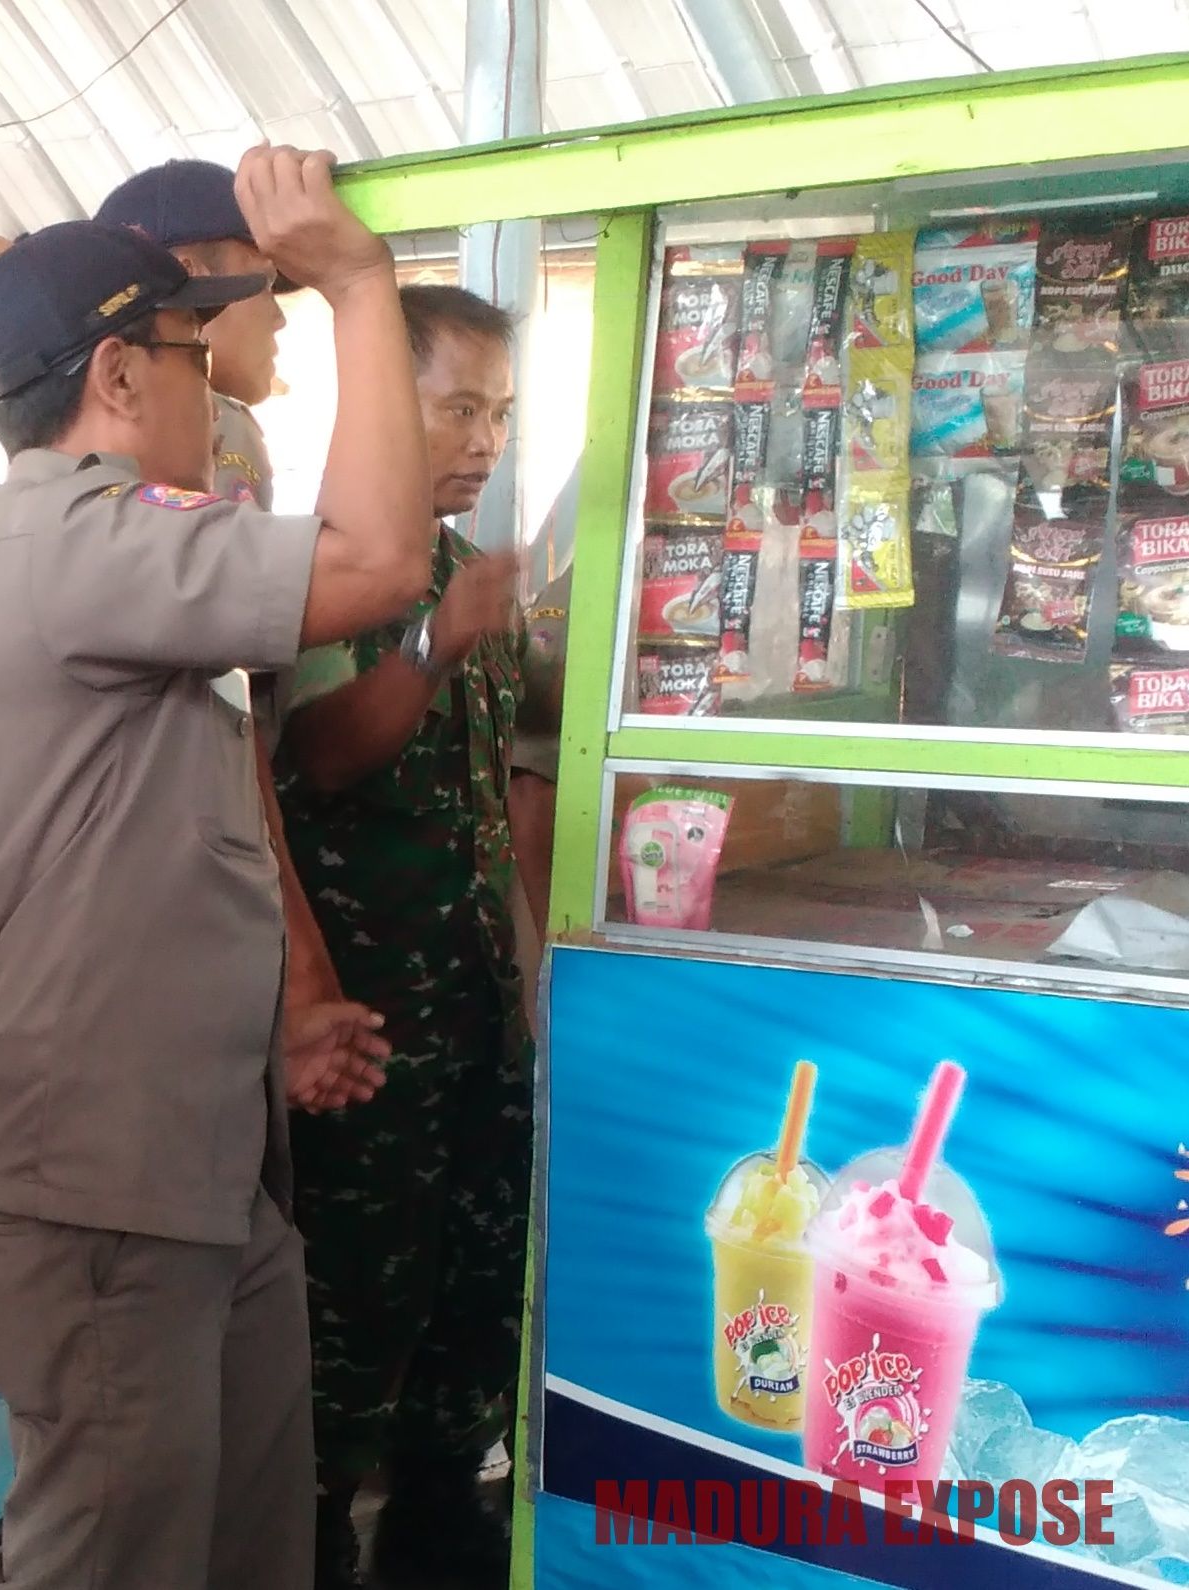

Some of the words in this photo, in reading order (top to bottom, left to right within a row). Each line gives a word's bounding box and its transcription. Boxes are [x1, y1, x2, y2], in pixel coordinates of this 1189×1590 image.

[911, 270, 961, 287] Good
[969, 264, 1009, 281] Day
[911, 375, 961, 390] Good
[969, 371, 1010, 387] Day
[669, 418, 717, 433] TORA
[668, 432, 720, 450] MOKA
[666, 542, 710, 556] TORA
[664, 558, 712, 573] MOKA
[662, 665, 707, 679] TORA
[660, 678, 709, 694] MOKA
[1134, 674, 1188, 693] TORA
[1138, 692, 1184, 709] BIKA
[752, 1378, 795, 1392] DURIAN
[858, 1384, 904, 1403] BLENDER
[855, 1443, 916, 1462] STRAWBERRY
